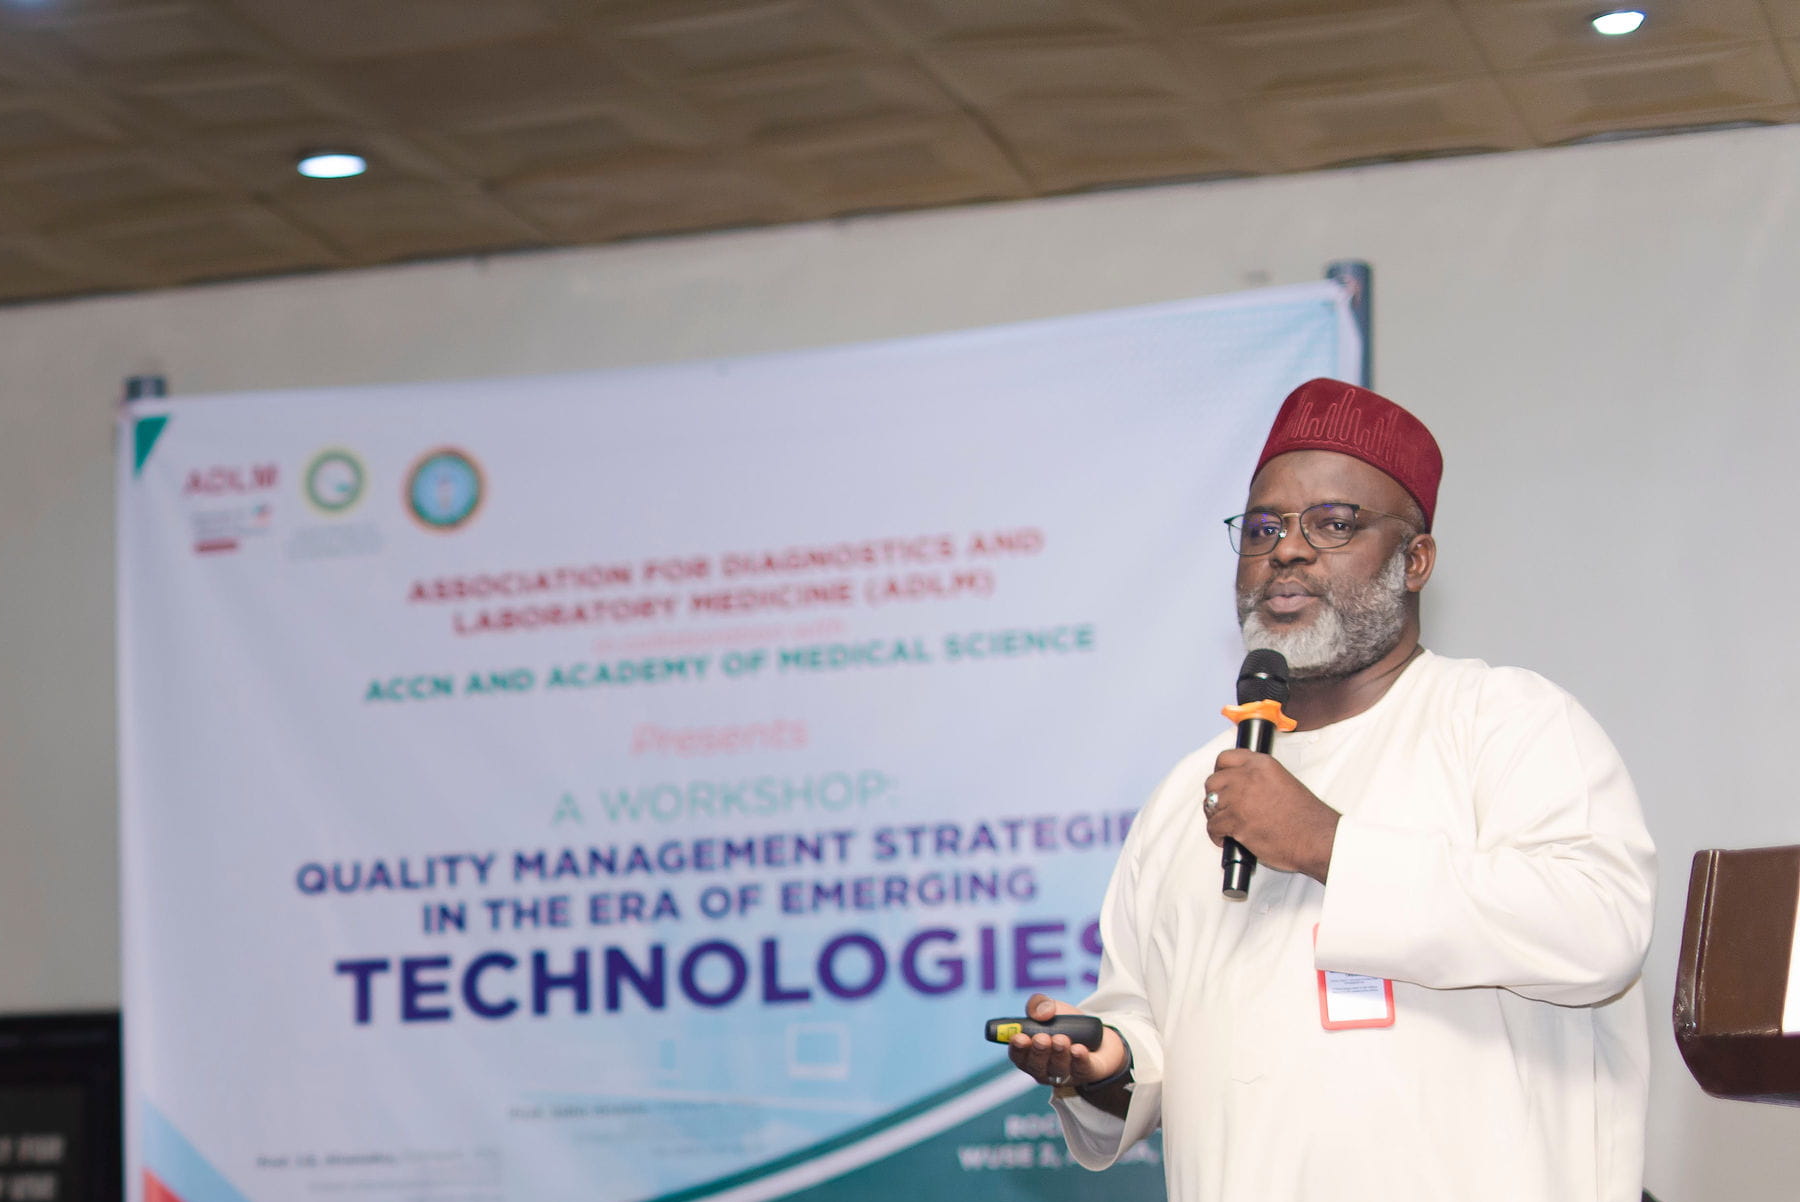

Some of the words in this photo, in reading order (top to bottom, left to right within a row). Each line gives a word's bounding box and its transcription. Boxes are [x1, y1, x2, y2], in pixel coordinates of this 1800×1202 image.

[407, 563, 633, 602] ASSOCIATION
[642, 556, 708, 587] FOR
[722, 535, 955, 578] DIAGNOSTICS
[967, 527, 1045, 556] AND
[452, 594, 676, 636] LABORATORY
[692, 577, 853, 613] MEDICINE
[863, 567, 996, 606] (ADLM)
[364, 672, 454, 702] ACCN
[465, 667, 535, 694] AND
[547, 654, 708, 691] ACADEMY
[720, 648, 767, 676] OF
[776, 635, 931, 672] MEDICAL
[943, 622, 1093, 661] SCIENCE
[630, 718, 808, 757] Presents
[552, 791, 584, 826] A
[600, 768, 898, 824] WORKSHOP:
[296, 851, 496, 895] QUALITY
[513, 830, 852, 883] MANAGEMENT
[423, 904, 467, 934] IN
[484, 895, 572, 930] THE
[589, 888, 681, 926] ERA
[700, 883, 763, 918] OF
[780, 867, 1039, 916] EMERGING
[334, 919, 1103, 1025] TECHNOLOGIES
